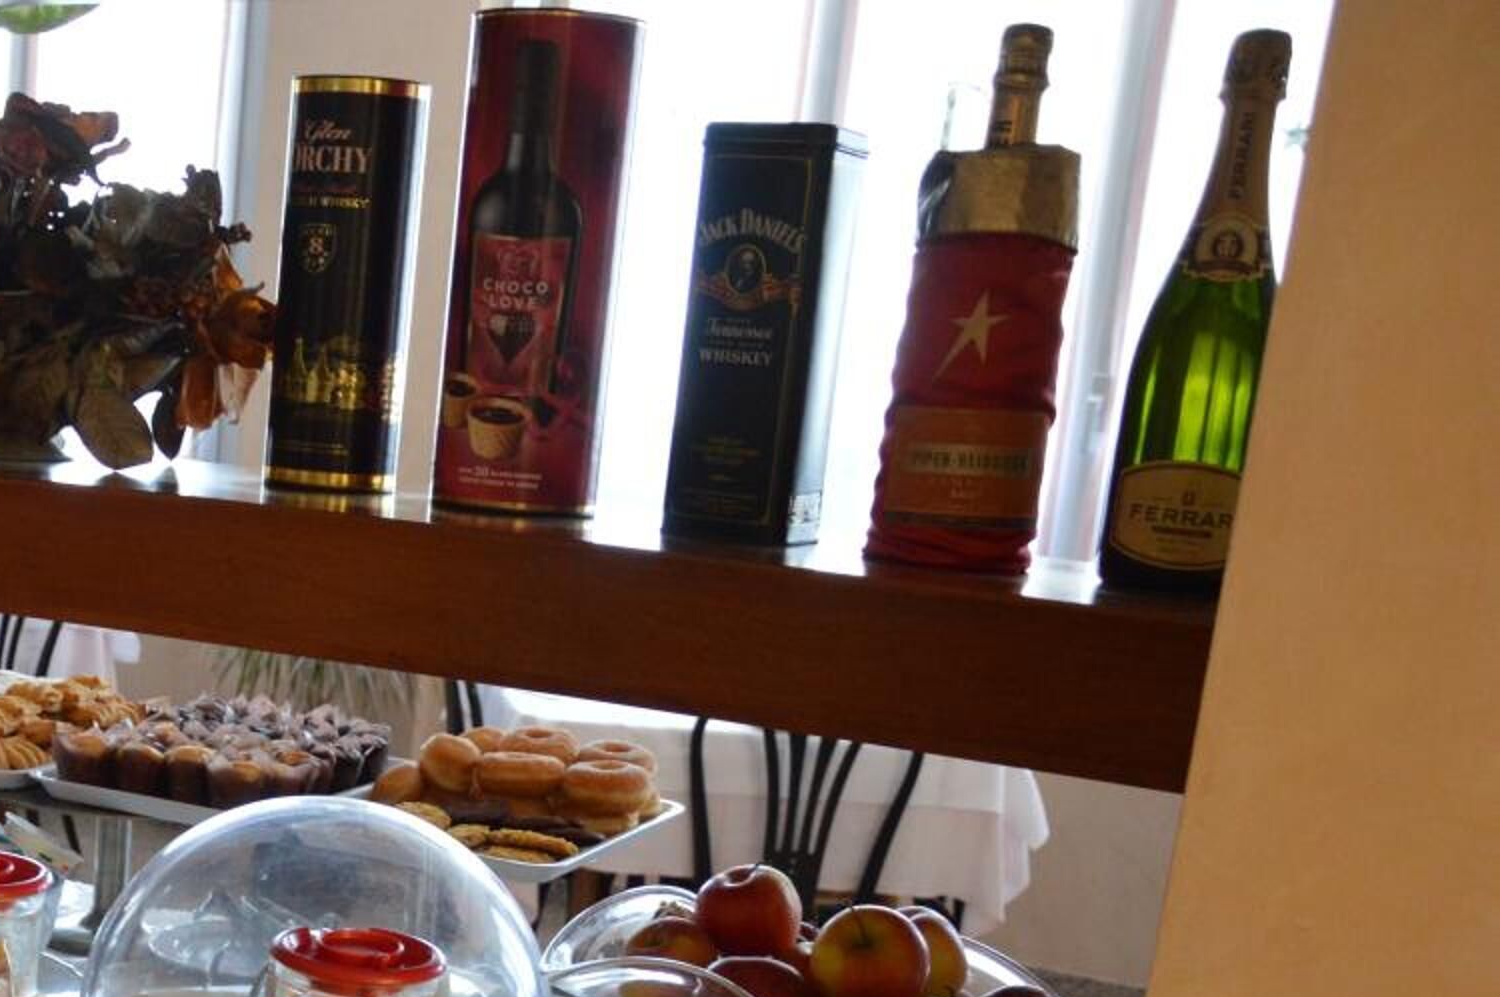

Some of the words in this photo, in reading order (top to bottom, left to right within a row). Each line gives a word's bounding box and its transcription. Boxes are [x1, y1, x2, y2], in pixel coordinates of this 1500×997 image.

[699, 215, 738, 246] JACK
[483, 277, 549, 296] CHOCO
[488, 294, 537, 312] LOVE
[699, 348, 773, 367] WHISKEY
[1129, 503, 1235, 528] FERRAR
